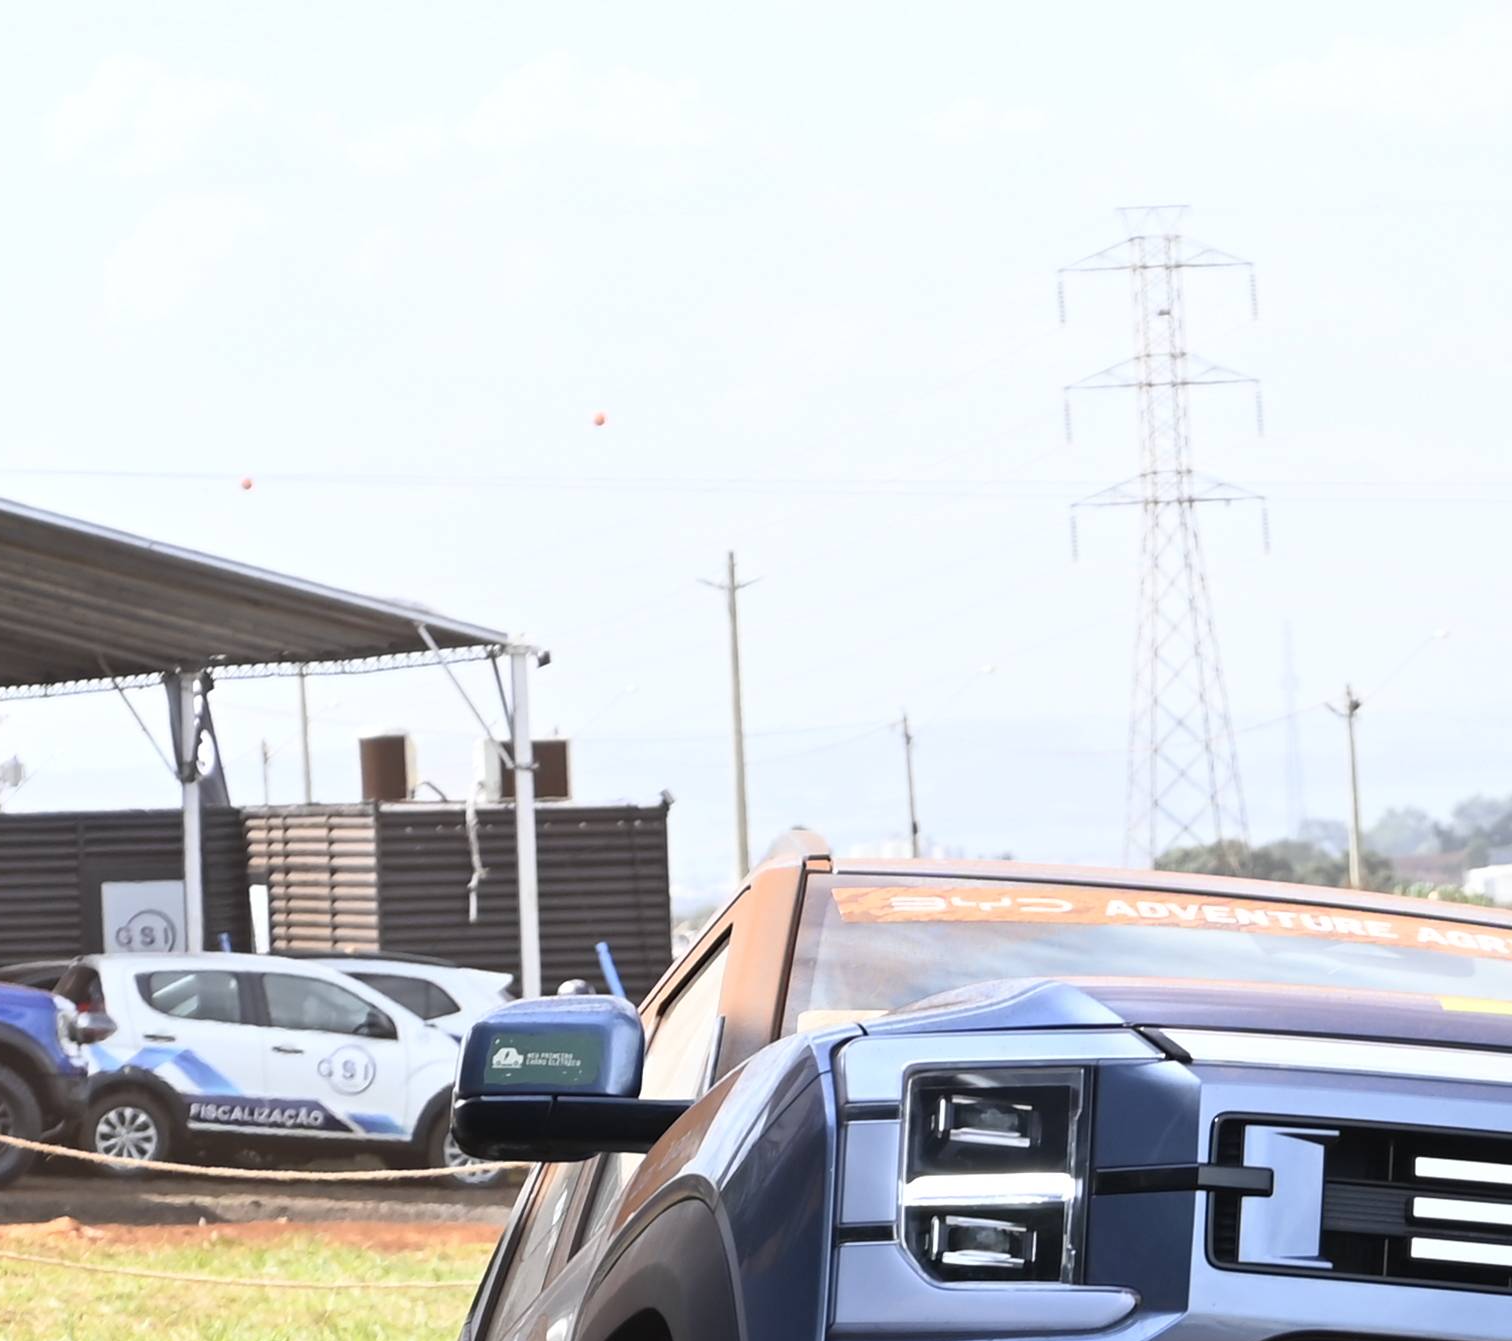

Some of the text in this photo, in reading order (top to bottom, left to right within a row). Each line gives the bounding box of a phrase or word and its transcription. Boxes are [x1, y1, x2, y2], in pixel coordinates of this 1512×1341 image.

[890, 895, 1073, 913] BYD
[1105, 899, 1400, 940] ADVENTURE
[115, 925, 169, 948] GSI
[317, 1058, 370, 1080] GSI
[189, 1102, 325, 1127] FISCALIZAÇÃO
